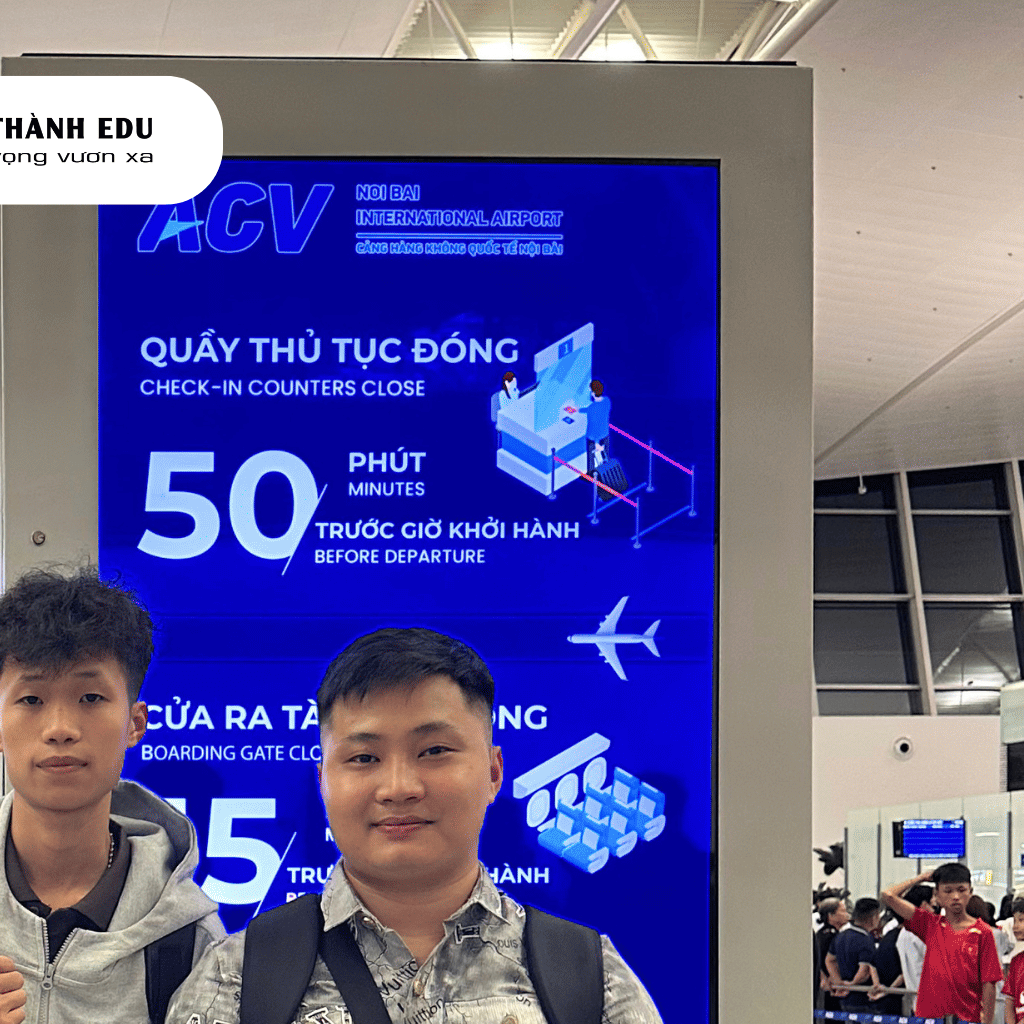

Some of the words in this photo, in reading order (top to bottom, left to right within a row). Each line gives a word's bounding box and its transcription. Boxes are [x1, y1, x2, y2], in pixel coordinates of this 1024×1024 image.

[356, 184, 387, 201] NOI
[389, 185, 420, 201] BAI
[137, 182, 334, 254] ACV
[356, 208, 488, 226] INTERNATIONAL
[490, 209, 563, 227] AIRPORT
[425, 240, 466, 254] KHÔNG
[542, 240, 563, 255] BÀI
[141, 328, 240, 367] QUẦY
[248, 329, 321, 363] THỦ
[332, 338, 401, 369] TỤC
[410, 332, 519, 363] ĐÓNG
[140, 380, 242, 396] CHECK-IN
[248, 380, 356, 396] COUNTERS
[362, 380, 425, 396] CLOSE
[348, 447, 426, 473] PHÚT
[348, 482, 425, 497] MINUTES
[137, 450, 318, 562] 50
[315, 517, 394, 540] TRƯỚC
[401, 517, 443, 540] GIỜ
[449, 516, 506, 539] KHỞI
[513, 517, 580, 539] HÀNH
[314, 549, 379, 564] BEFORE
[384, 549, 486, 564] DEPARTURE
[146, 696, 215, 730] CỬA
[225, 705, 274, 730] RA
[282, 699, 320, 730] TÀ
[141, 745, 235, 761] BOARDING
[241, 745, 285, 761] GATE
[289, 745, 322, 761] CLO
[287, 864, 333, 884] TRƯ
